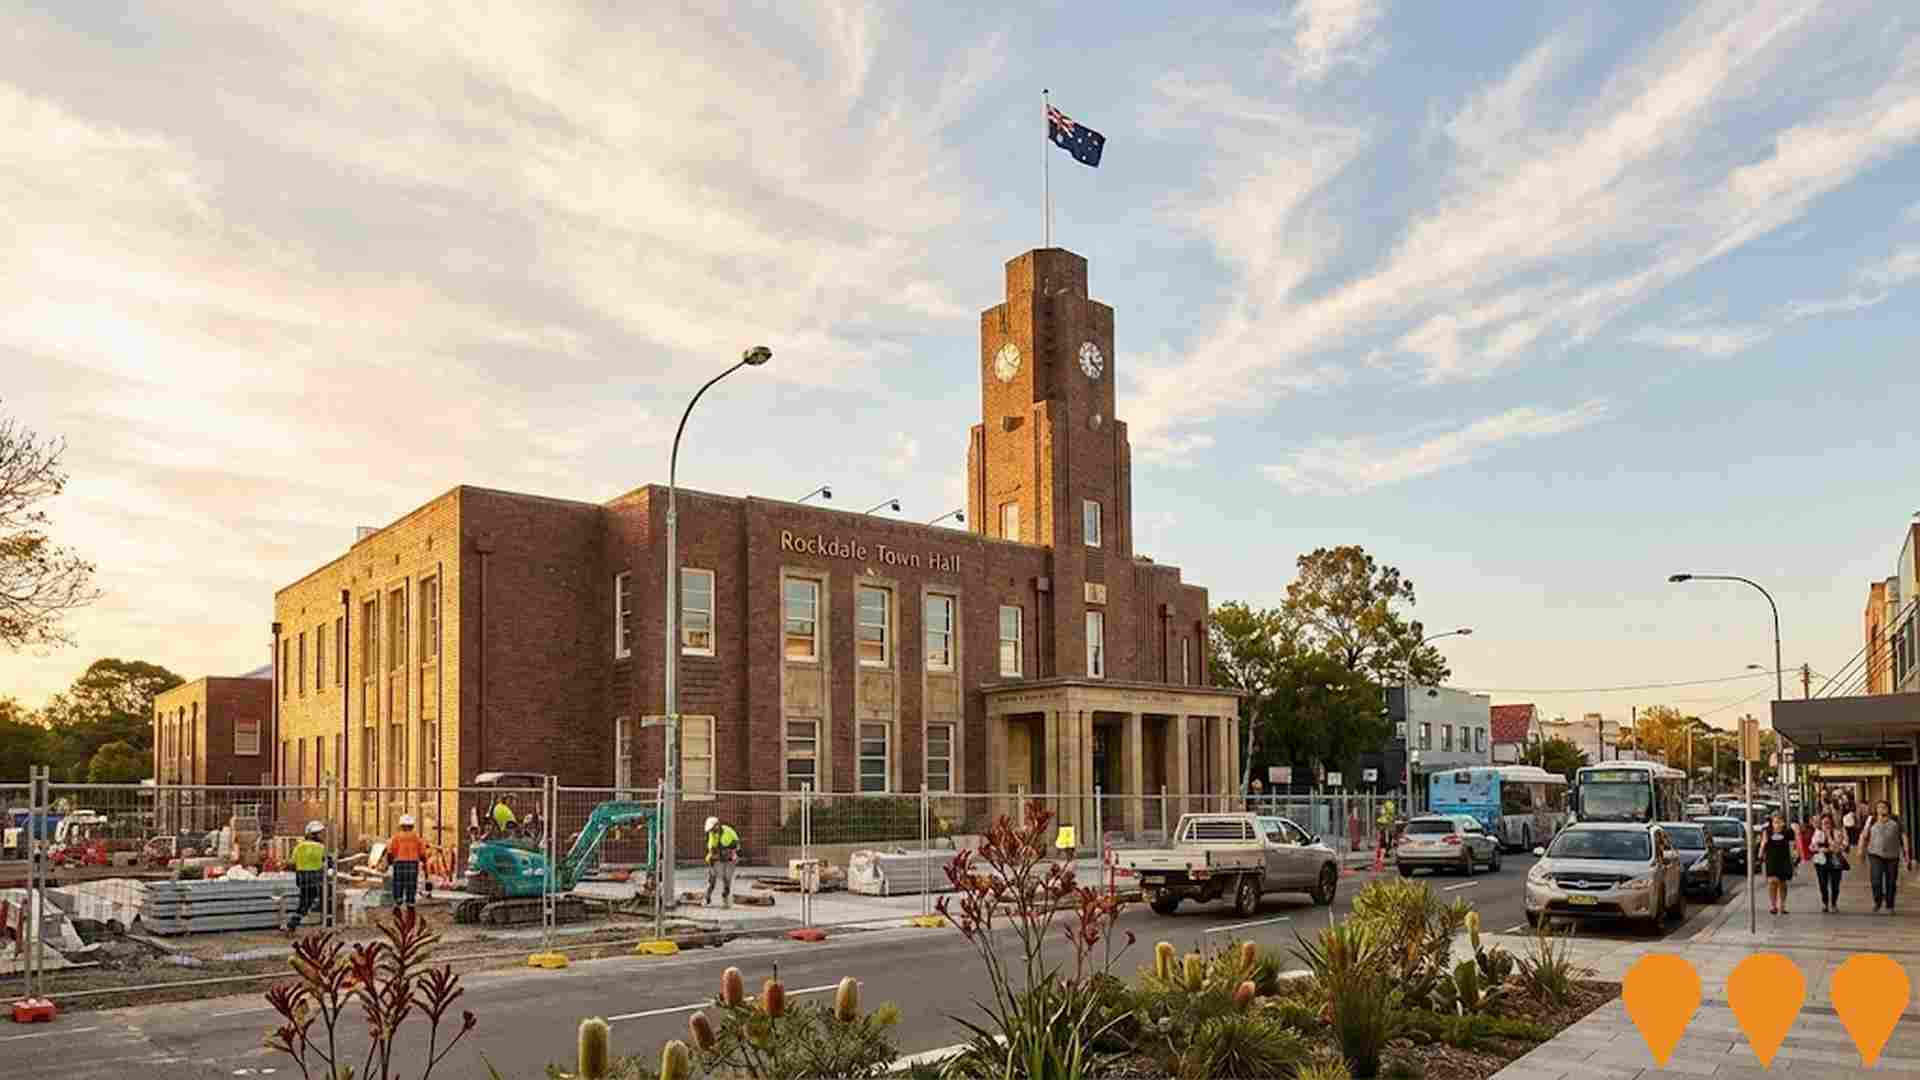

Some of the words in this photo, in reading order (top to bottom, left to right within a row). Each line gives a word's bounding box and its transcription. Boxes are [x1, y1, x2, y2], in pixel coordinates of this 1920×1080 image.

[780, 529, 867, 561] Rockdale
[876, 544, 920, 567] Town
[929, 552, 960, 573] Hall
